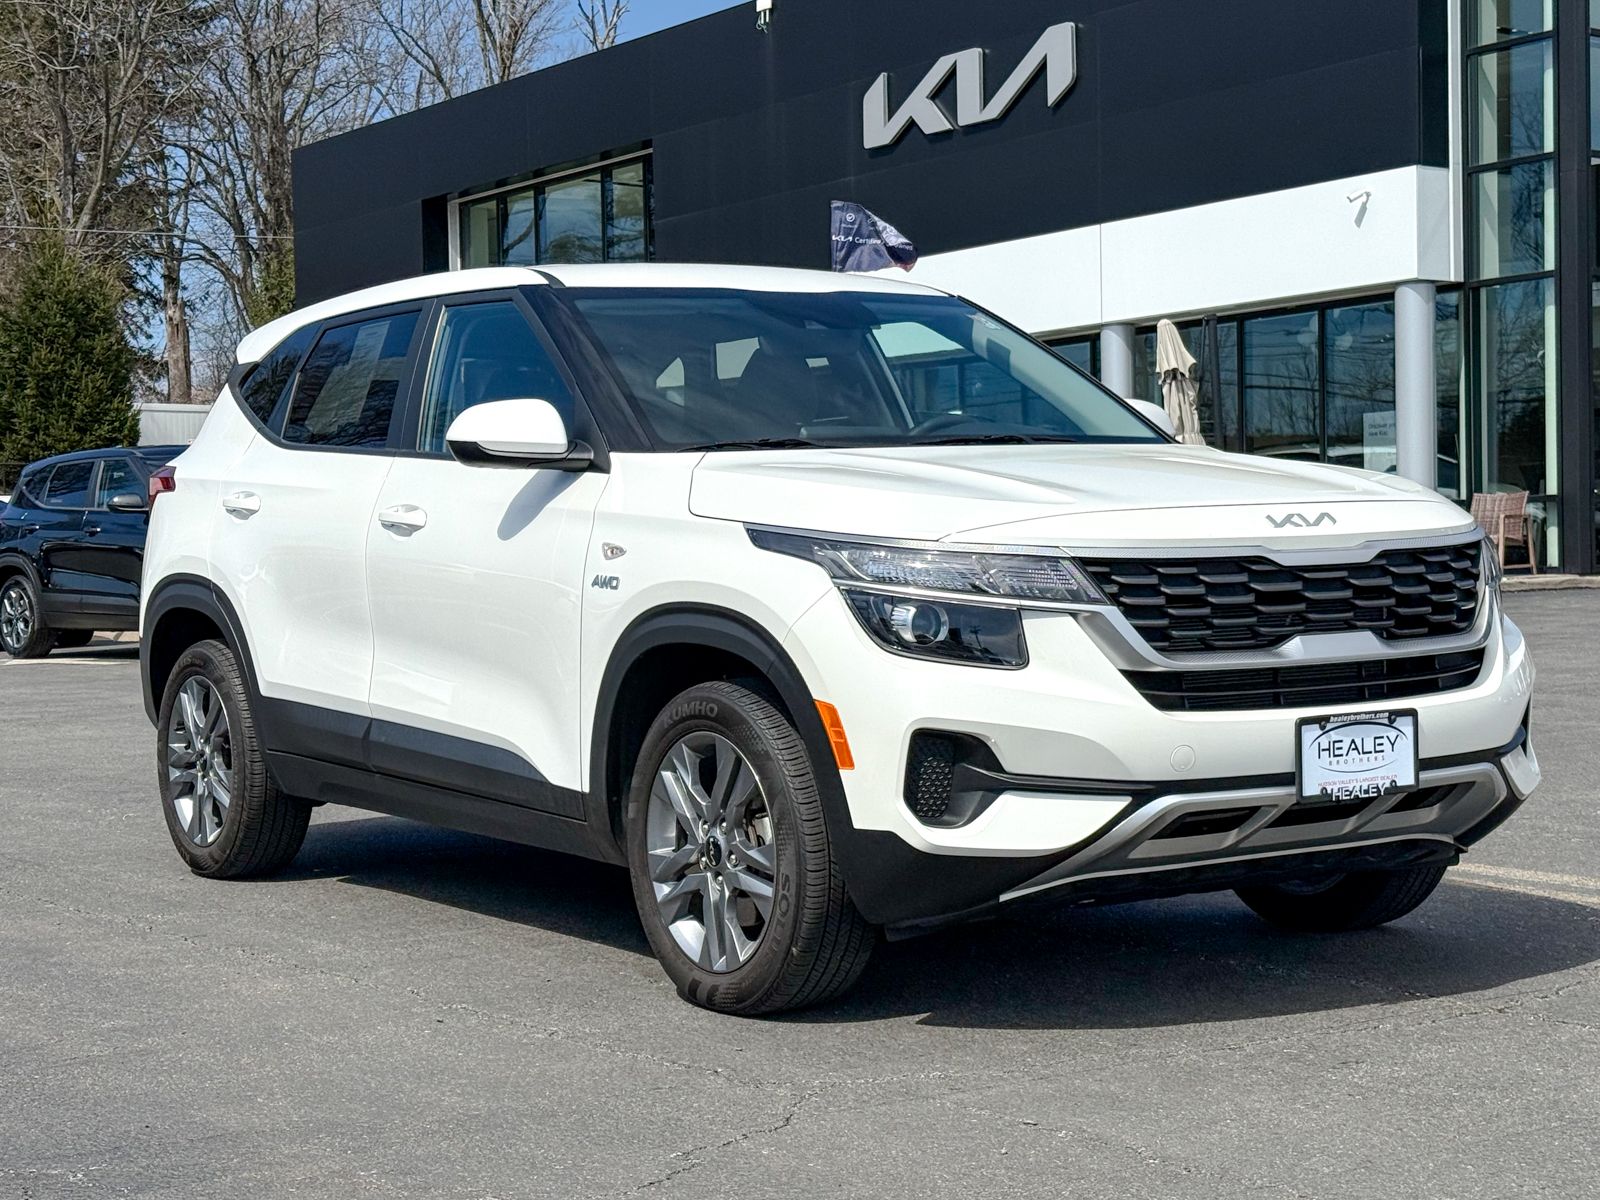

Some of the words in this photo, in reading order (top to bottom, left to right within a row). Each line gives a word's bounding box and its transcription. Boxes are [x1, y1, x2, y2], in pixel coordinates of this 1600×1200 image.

[862, 21, 1077, 150] KIA
[1265, 512, 1337, 529] KIA
[591, 574, 621, 590] AWD
[1329, 712, 1389, 723] healeybrothers.com
[1318, 734, 1399, 759] HEALEY
[1329, 755, 1385, 766] BROTHERS
[1332, 782, 1386, 801] HEALEY
